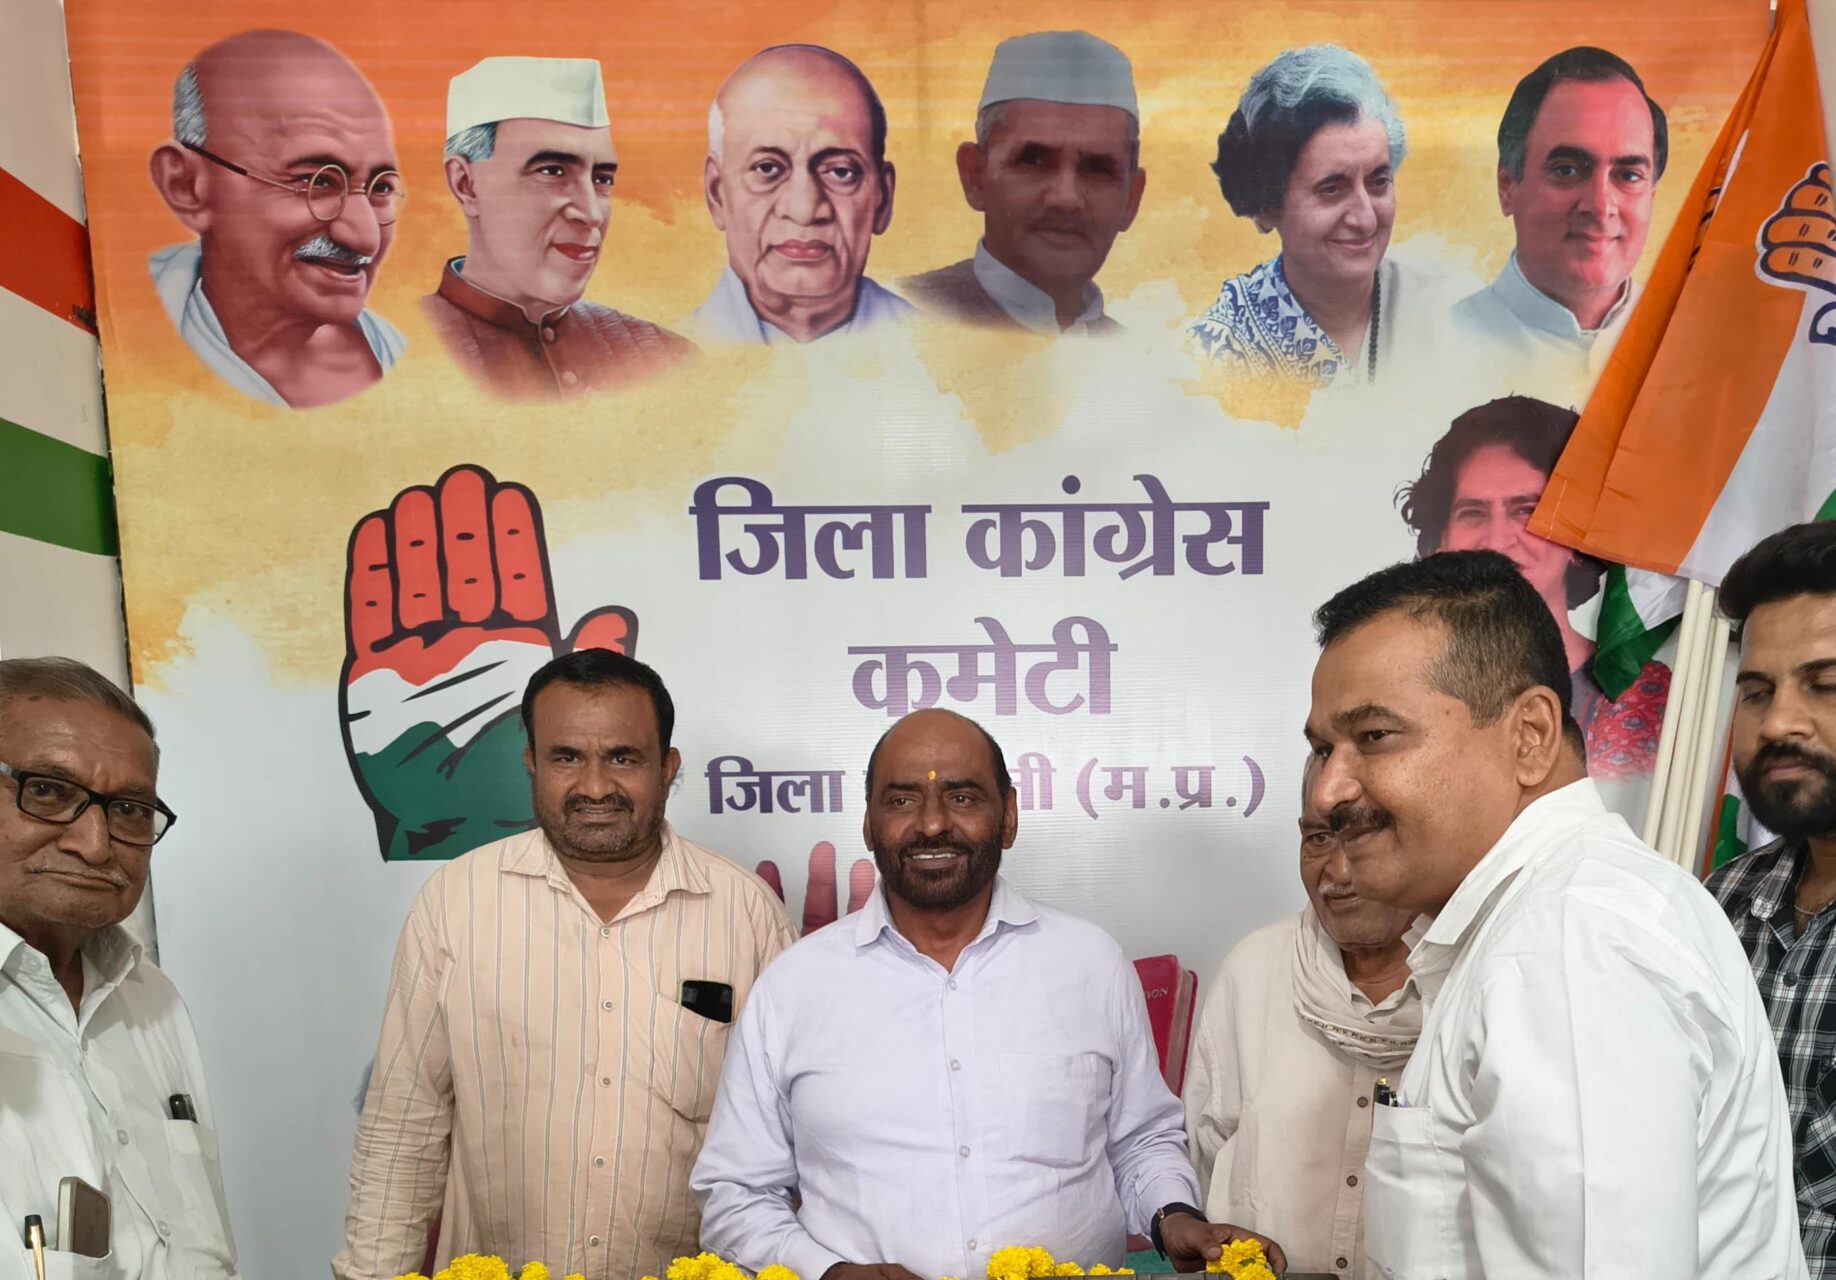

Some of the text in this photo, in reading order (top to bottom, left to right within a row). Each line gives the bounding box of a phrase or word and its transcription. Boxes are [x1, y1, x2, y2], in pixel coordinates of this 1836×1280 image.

[689, 474, 1270, 581] जिला कांग्रेस
[848, 616, 1118, 717] कमेटी
[704, 755, 846, 815] जिला
